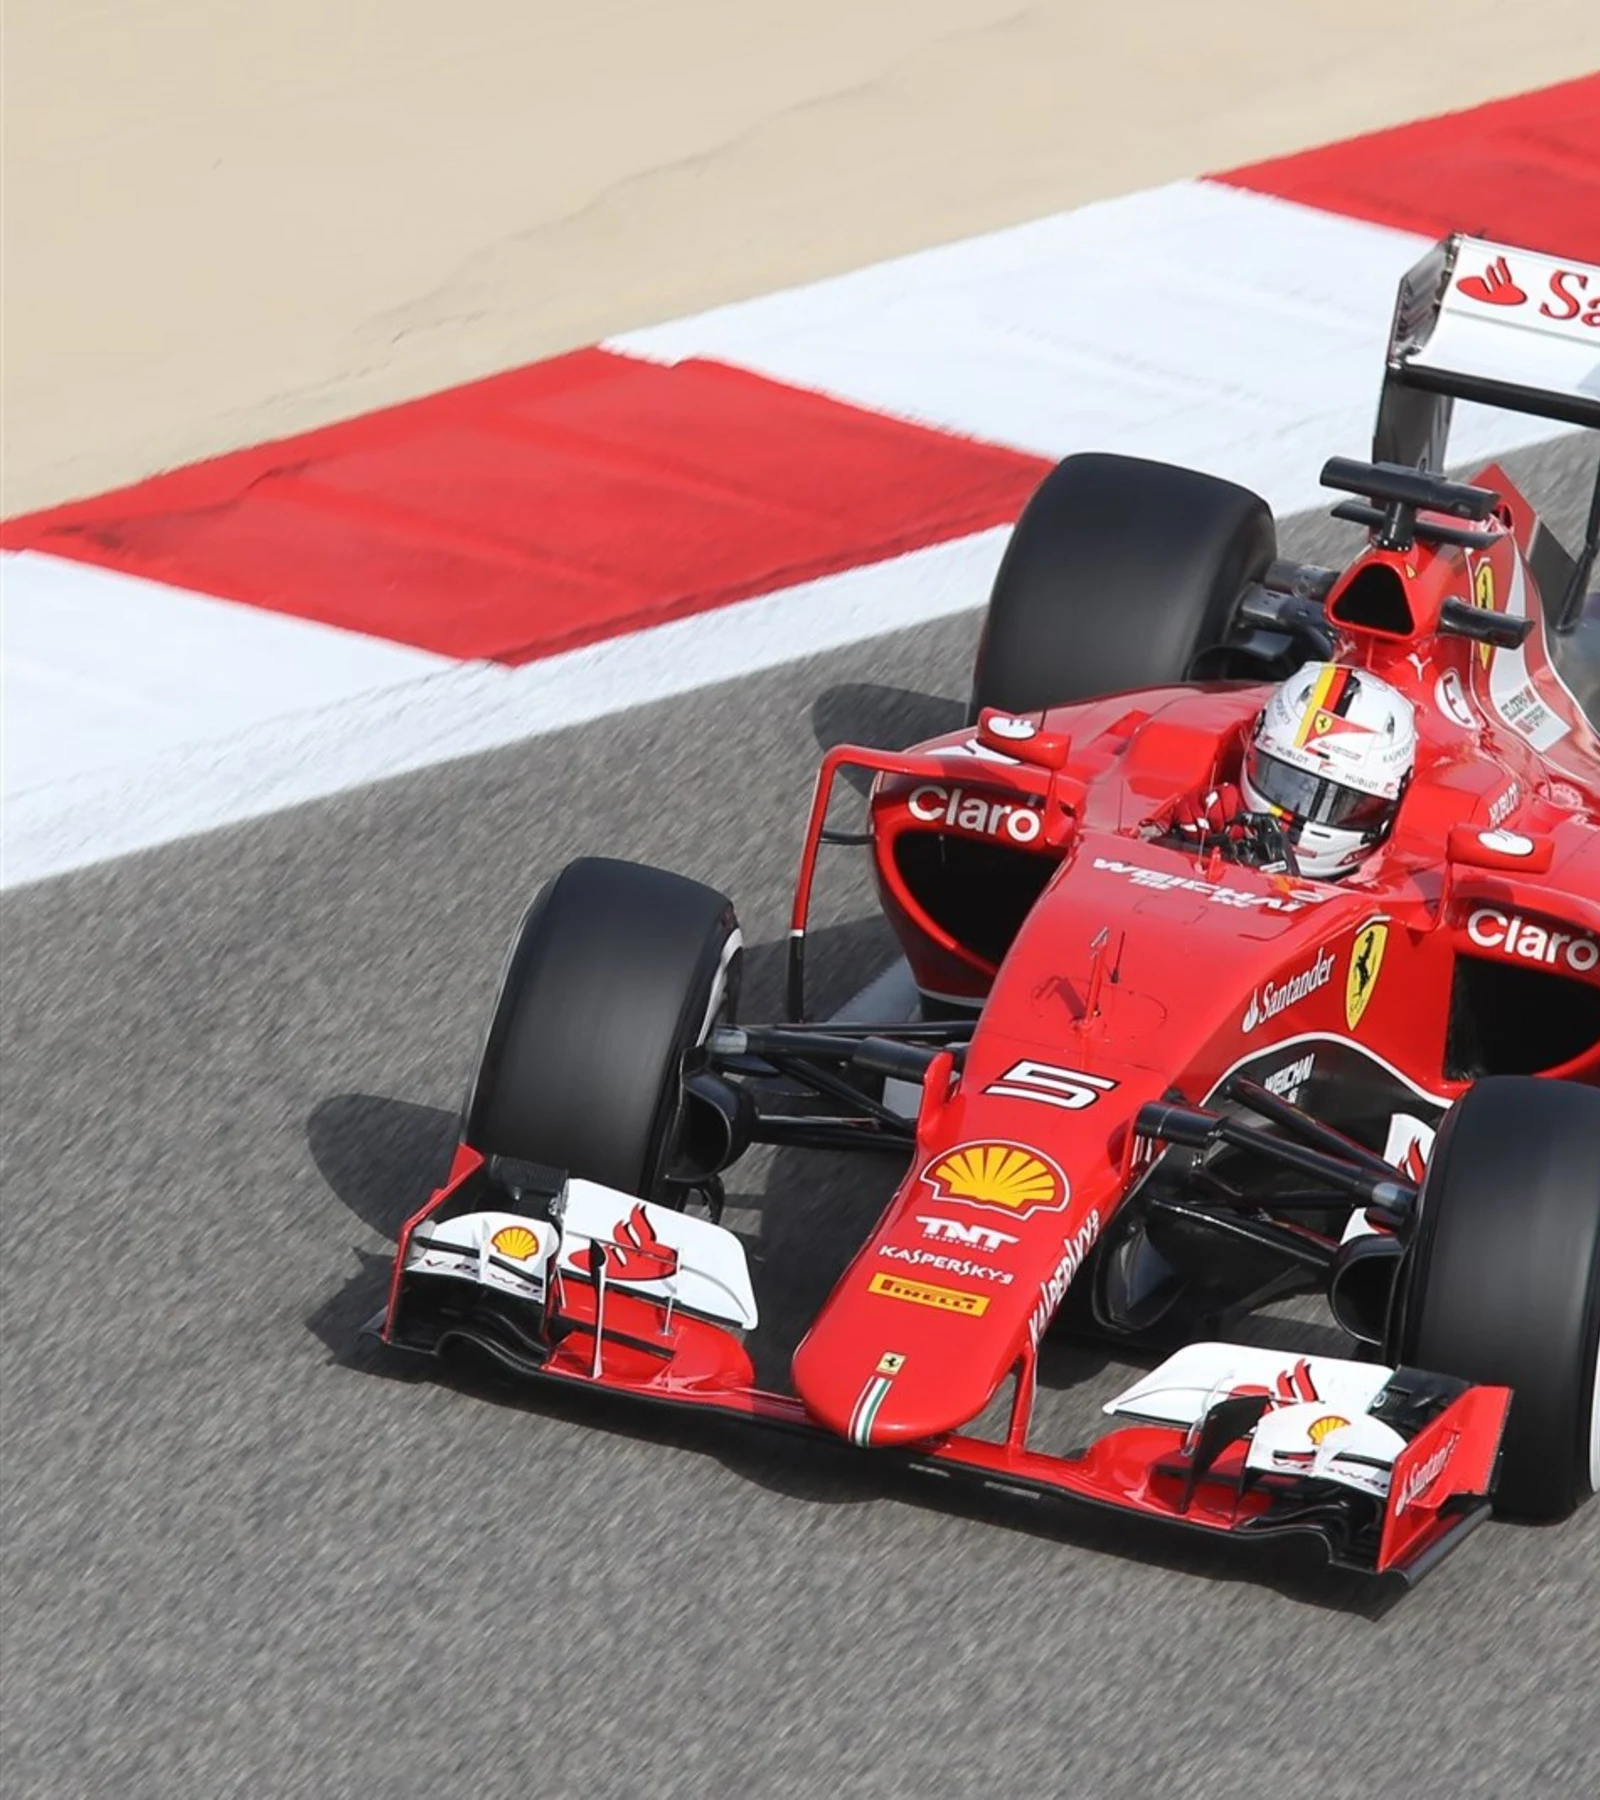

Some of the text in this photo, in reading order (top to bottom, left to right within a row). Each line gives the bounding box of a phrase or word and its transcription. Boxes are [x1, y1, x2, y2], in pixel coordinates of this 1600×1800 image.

[908, 785, 1040, 842] Claro
[1467, 908, 1599, 971] Claro
[1259, 946, 1336, 1024] Santander
[980, 1058, 1120, 1110] 5
[915, 1215, 1020, 1249] TNT
[879, 1245, 1004, 1281] KASPERSKY
[880, 1279, 977, 1310] PIRELLI
